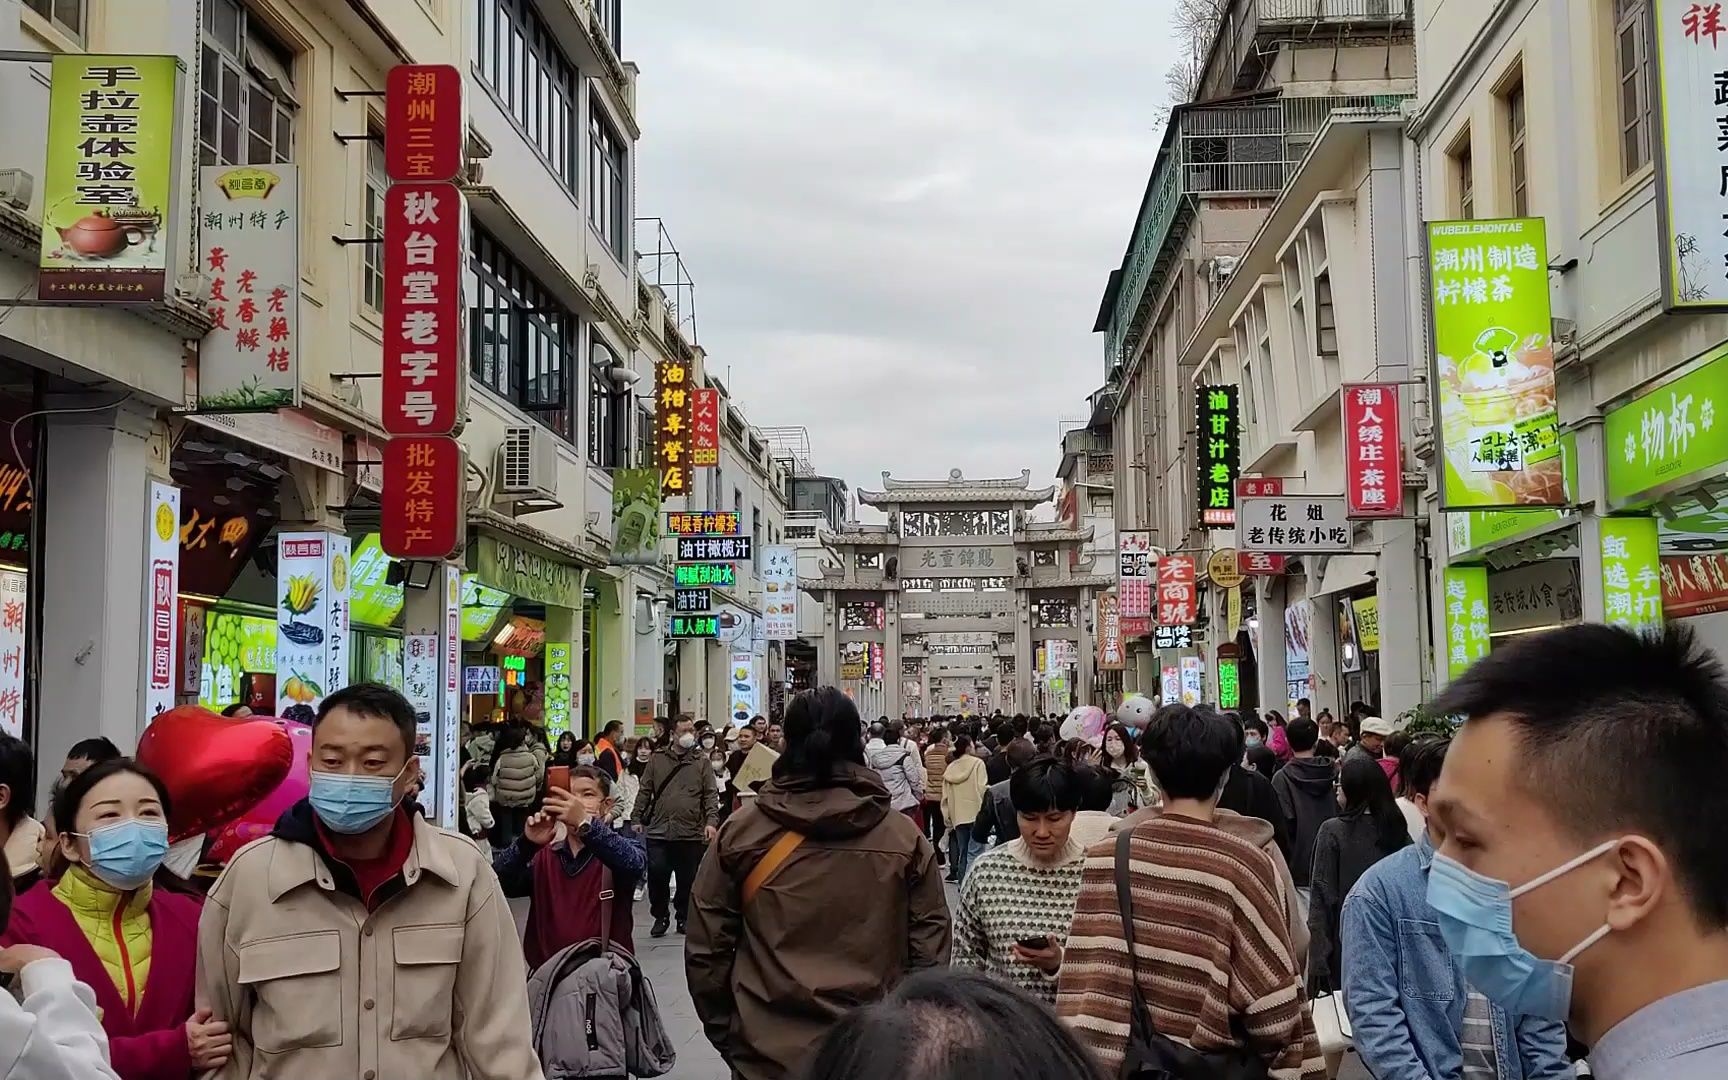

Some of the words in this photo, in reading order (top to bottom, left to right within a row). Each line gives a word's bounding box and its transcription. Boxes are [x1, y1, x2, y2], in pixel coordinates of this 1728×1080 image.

[75, 66, 142, 205] 手拉壶体验室
[406, 72, 436, 176] 潮州三宝
[1434, 243, 1539, 273] 潮州制造
[399, 190, 440, 427] 秋台堂老字号
[1437, 274, 1514, 305] 柠檬茶
[1208, 390, 1230, 508] 油甘汁老店
[1470, 430, 1519, 447] 一口上头
[1641, 392, 1696, 468] 物杯
[404, 443, 435, 549] 批发特产
[1245, 482, 1274, 495] 老店
[669, 515, 738, 533] 鸭屎香柠檬茶
[1247, 526, 1348, 545] 老传统小吃
[680, 539, 749, 558] 油甘橄榄汁
[677, 590, 708, 609] 油甘汁
[1159, 557, 1195, 624] 老商號
[1602, 535, 1630, 626] 甄选潮
[673, 618, 716, 635] 黑人叔叔
[551, 648, 566, 686] 油甘汁
[1219, 663, 1236, 708] 油甘汁
